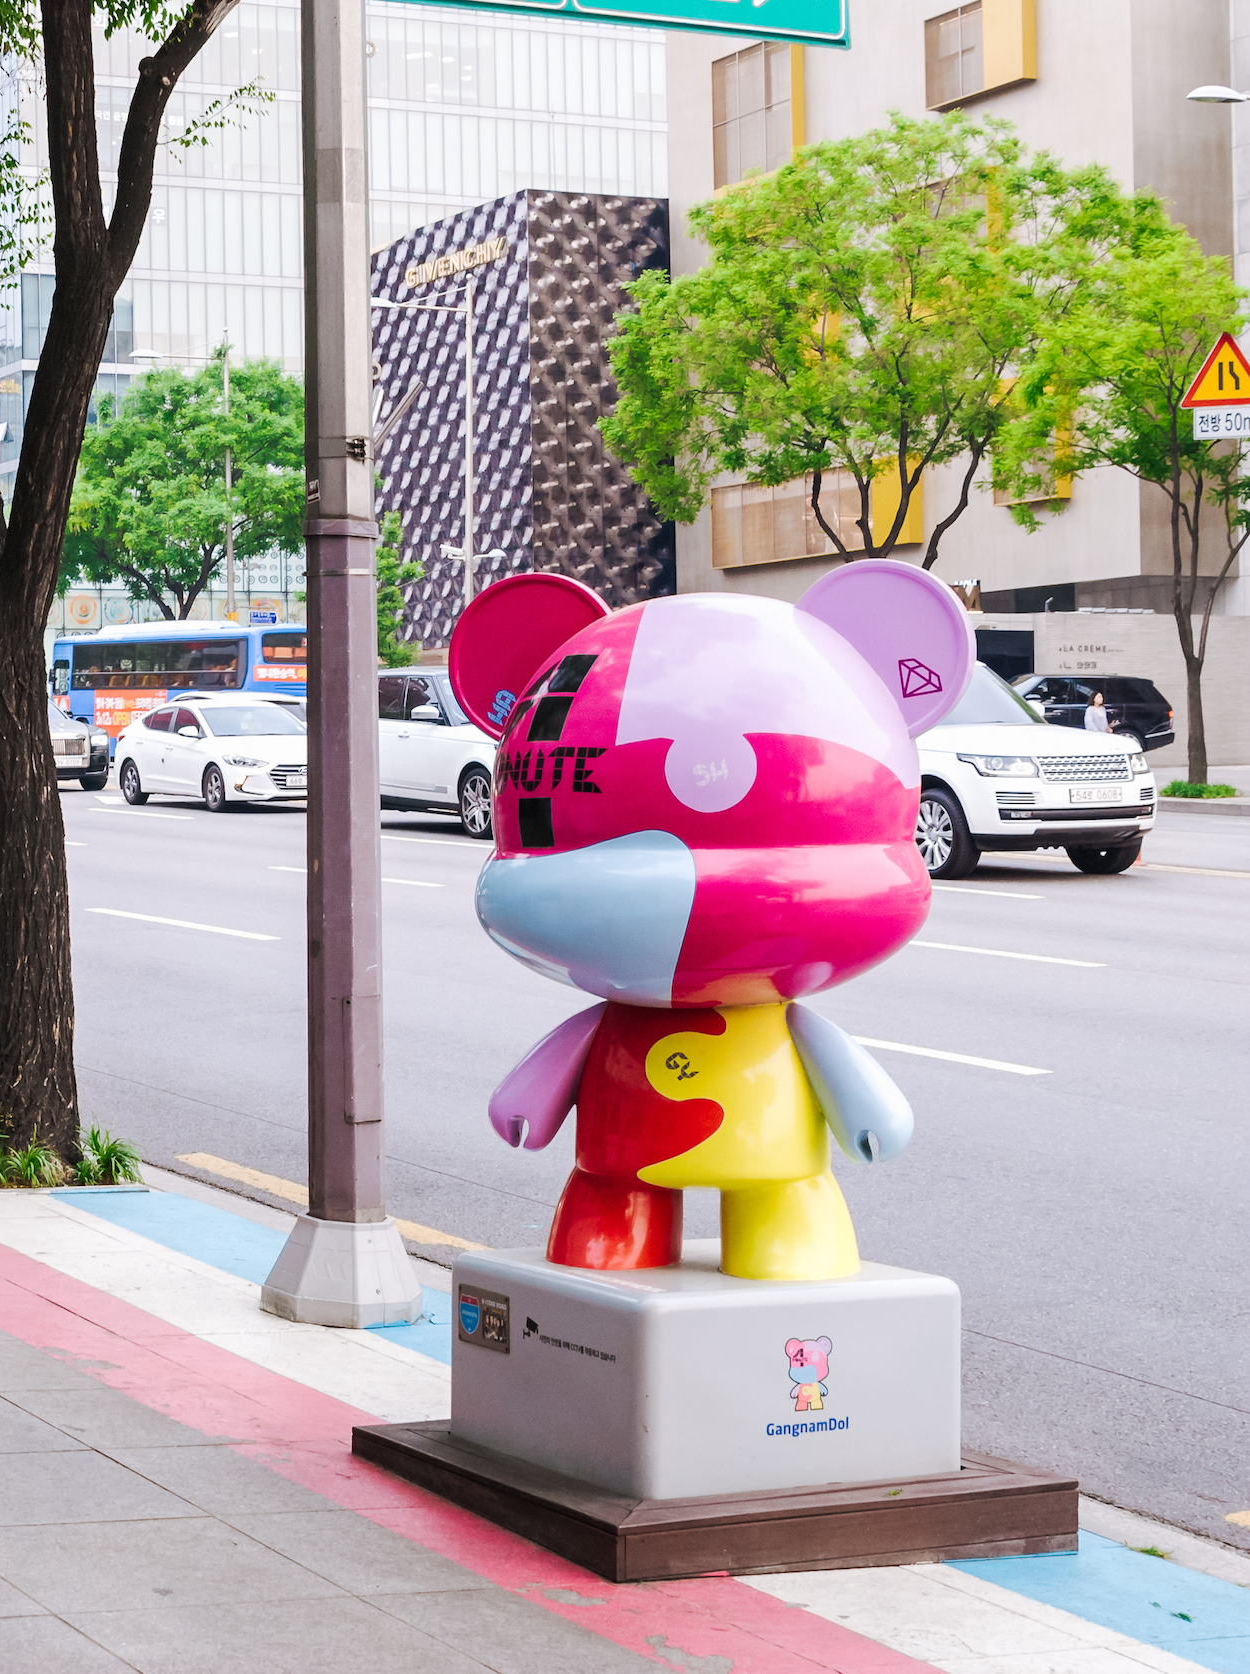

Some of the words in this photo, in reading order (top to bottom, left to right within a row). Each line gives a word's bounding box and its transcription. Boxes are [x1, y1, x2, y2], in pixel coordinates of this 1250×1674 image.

[405, 236, 509, 289] GIVENCHY
[1198, 414, 1221, 433] 전방
[1096, 788, 1118, 800] 0608
[766, 1416, 850, 1438] GangnamDol
